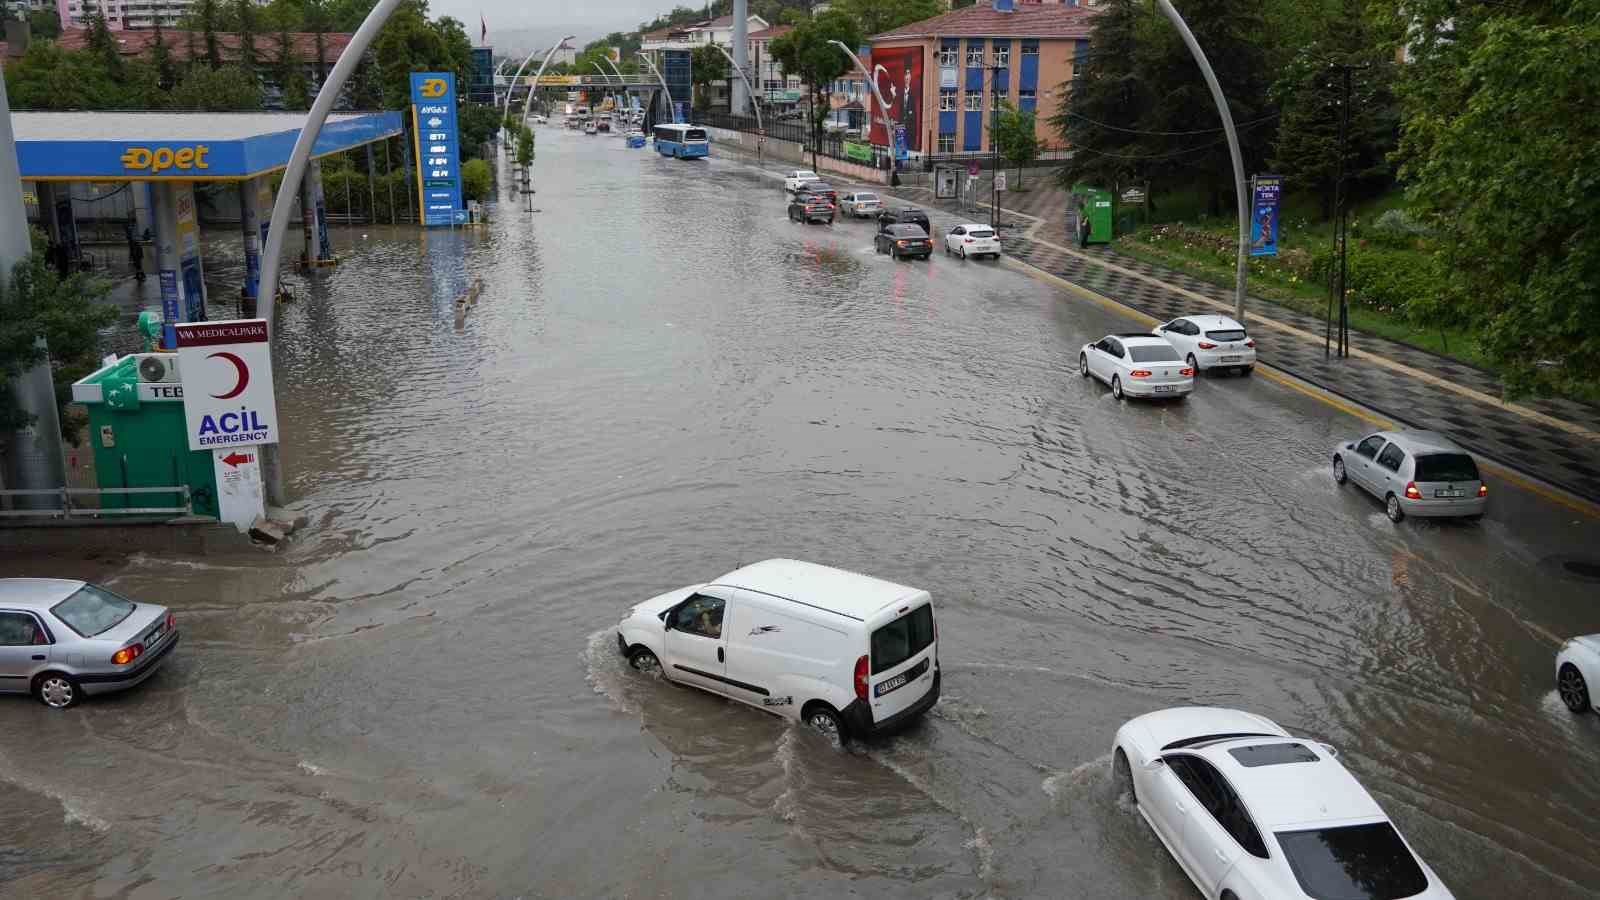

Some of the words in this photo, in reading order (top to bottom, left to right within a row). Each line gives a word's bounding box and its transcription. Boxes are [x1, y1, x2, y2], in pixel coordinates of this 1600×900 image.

[120, 145, 209, 173] opet
[196, 325, 265, 338] MEDICALPARK
[150, 386, 184, 398] TEB
[199, 405, 269, 436] ACİL
[199, 431, 268, 446] EMERGENCY
